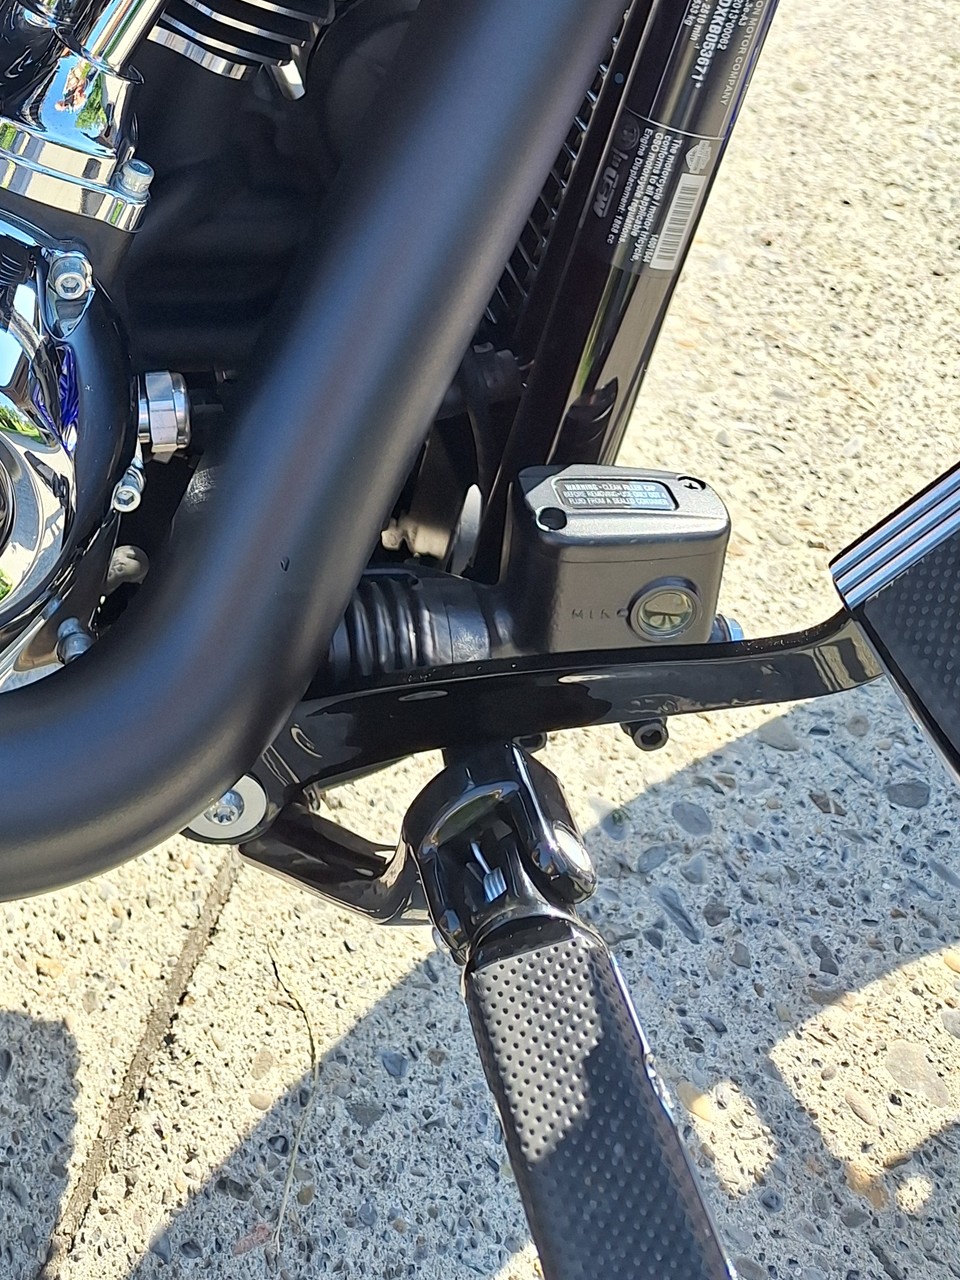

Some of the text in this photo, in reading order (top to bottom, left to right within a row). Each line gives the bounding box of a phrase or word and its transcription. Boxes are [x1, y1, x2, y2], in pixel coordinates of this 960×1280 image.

[682, 12, 696, 27] kg
[737, 16, 757, 55] MOTOR
[718, 55, 743, 106] COMPANY
[634, 126, 654, 157] Engine
[648, 130, 664, 153] GSO
[668, 136, 683, 155] The
[613, 155, 644, 214] Displacement:
[627, 133, 674, 238] conforms to all applicable
[631, 150, 657, 199] motorcycle
[649, 152, 676, 202] motorcycle
[614, 196, 641, 246] regulations.
[641, 204, 658, 231] motor
[605, 232, 615, 245] cc
